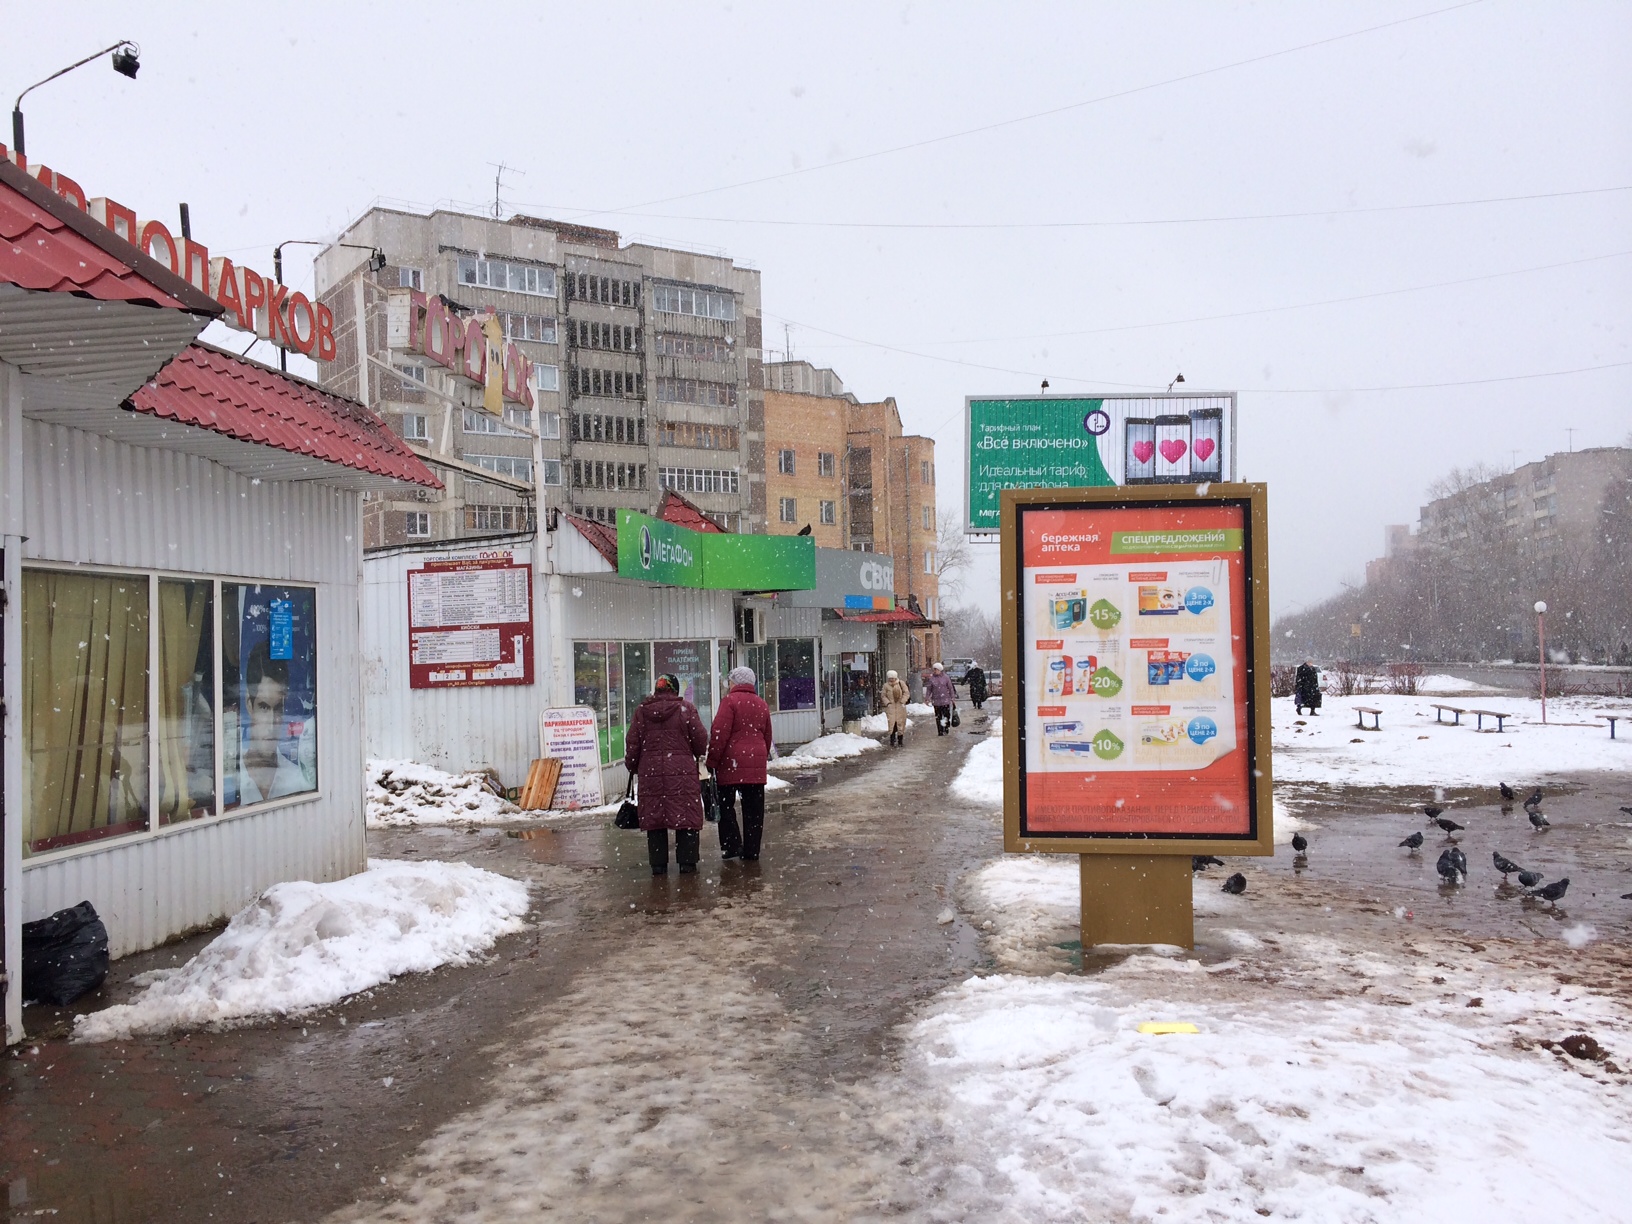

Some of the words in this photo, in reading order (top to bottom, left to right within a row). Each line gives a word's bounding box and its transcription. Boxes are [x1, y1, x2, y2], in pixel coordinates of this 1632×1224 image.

[980, 423, 1020, 433] Тарифный
[1022, 424, 1041, 432] план
[977, 435, 1009, 450] «Всё
[1012, 437, 1089, 450] включено»
[979, 464, 1047, 477] Идеальный
[979, 481, 1002, 492] для
[1041, 532, 1099, 545] бережная
[1121, 533, 1226, 545] СПЕЦПРЕДЛОЖЕНИЯ
[1041, 543, 1081, 552] аптека
[1191, 592, 1197, 600] 3
[1090, 608, 1118, 621] -15%
[1193, 659, 1199, 667] 3
[1090, 676, 1119, 689] -20%
[544, 719, 593, 728] ПАРИКМАХЕРСКАЯ
[1092, 738, 1121, 751] -10%
[1154, 805, 1180, 814] ПЕРЕД
